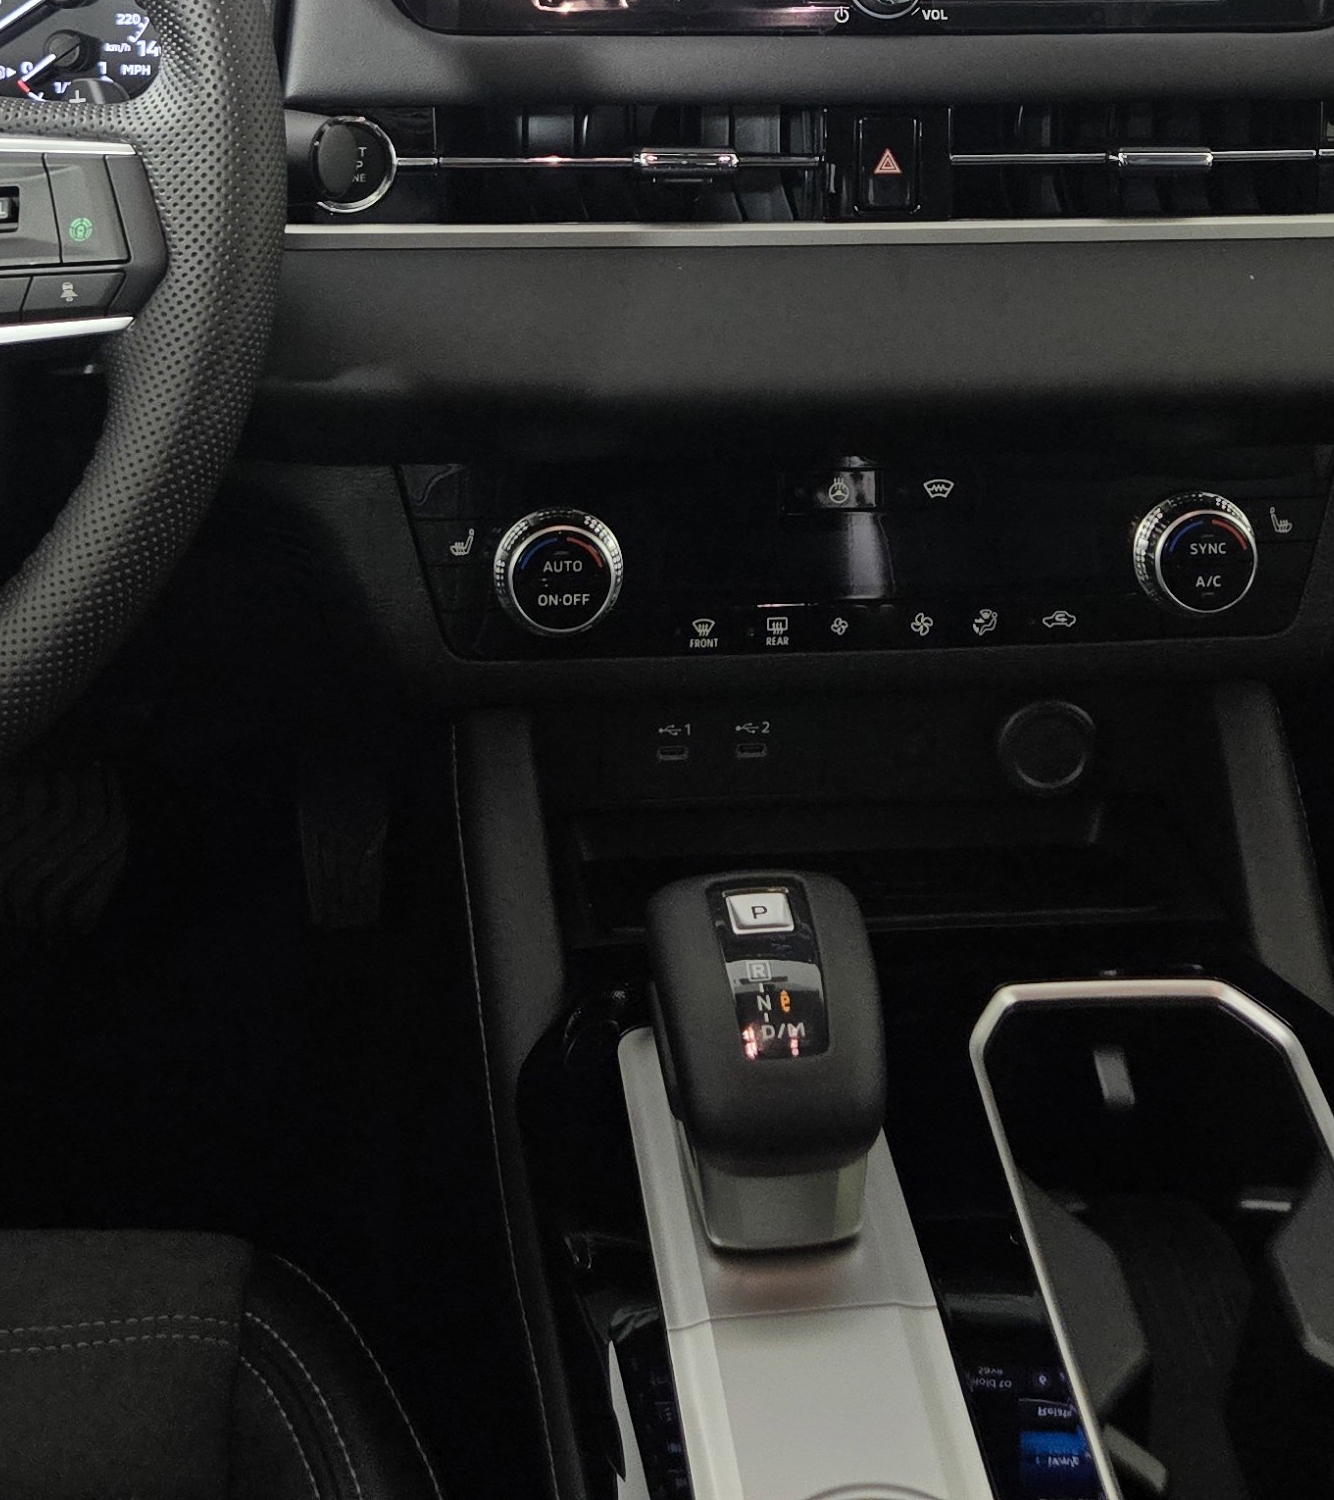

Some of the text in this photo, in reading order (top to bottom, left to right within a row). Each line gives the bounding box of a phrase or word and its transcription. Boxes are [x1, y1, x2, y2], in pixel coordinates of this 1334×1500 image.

[116, 13, 142, 25] 220
[922, 9, 948, 21] VOL
[120, 64, 152, 76] MPH
[1189, 542, 1227, 555] SYNC
[543, 560, 583, 573] AUTO
[1195, 575, 1222, 588] A/C
[689, 637, 719, 649] FRONT
[765, 636, 789, 646] REAR
[761, 721, 770, 734] 2
[751, 905, 768, 920] P
[756, 994, 772, 1011] N
